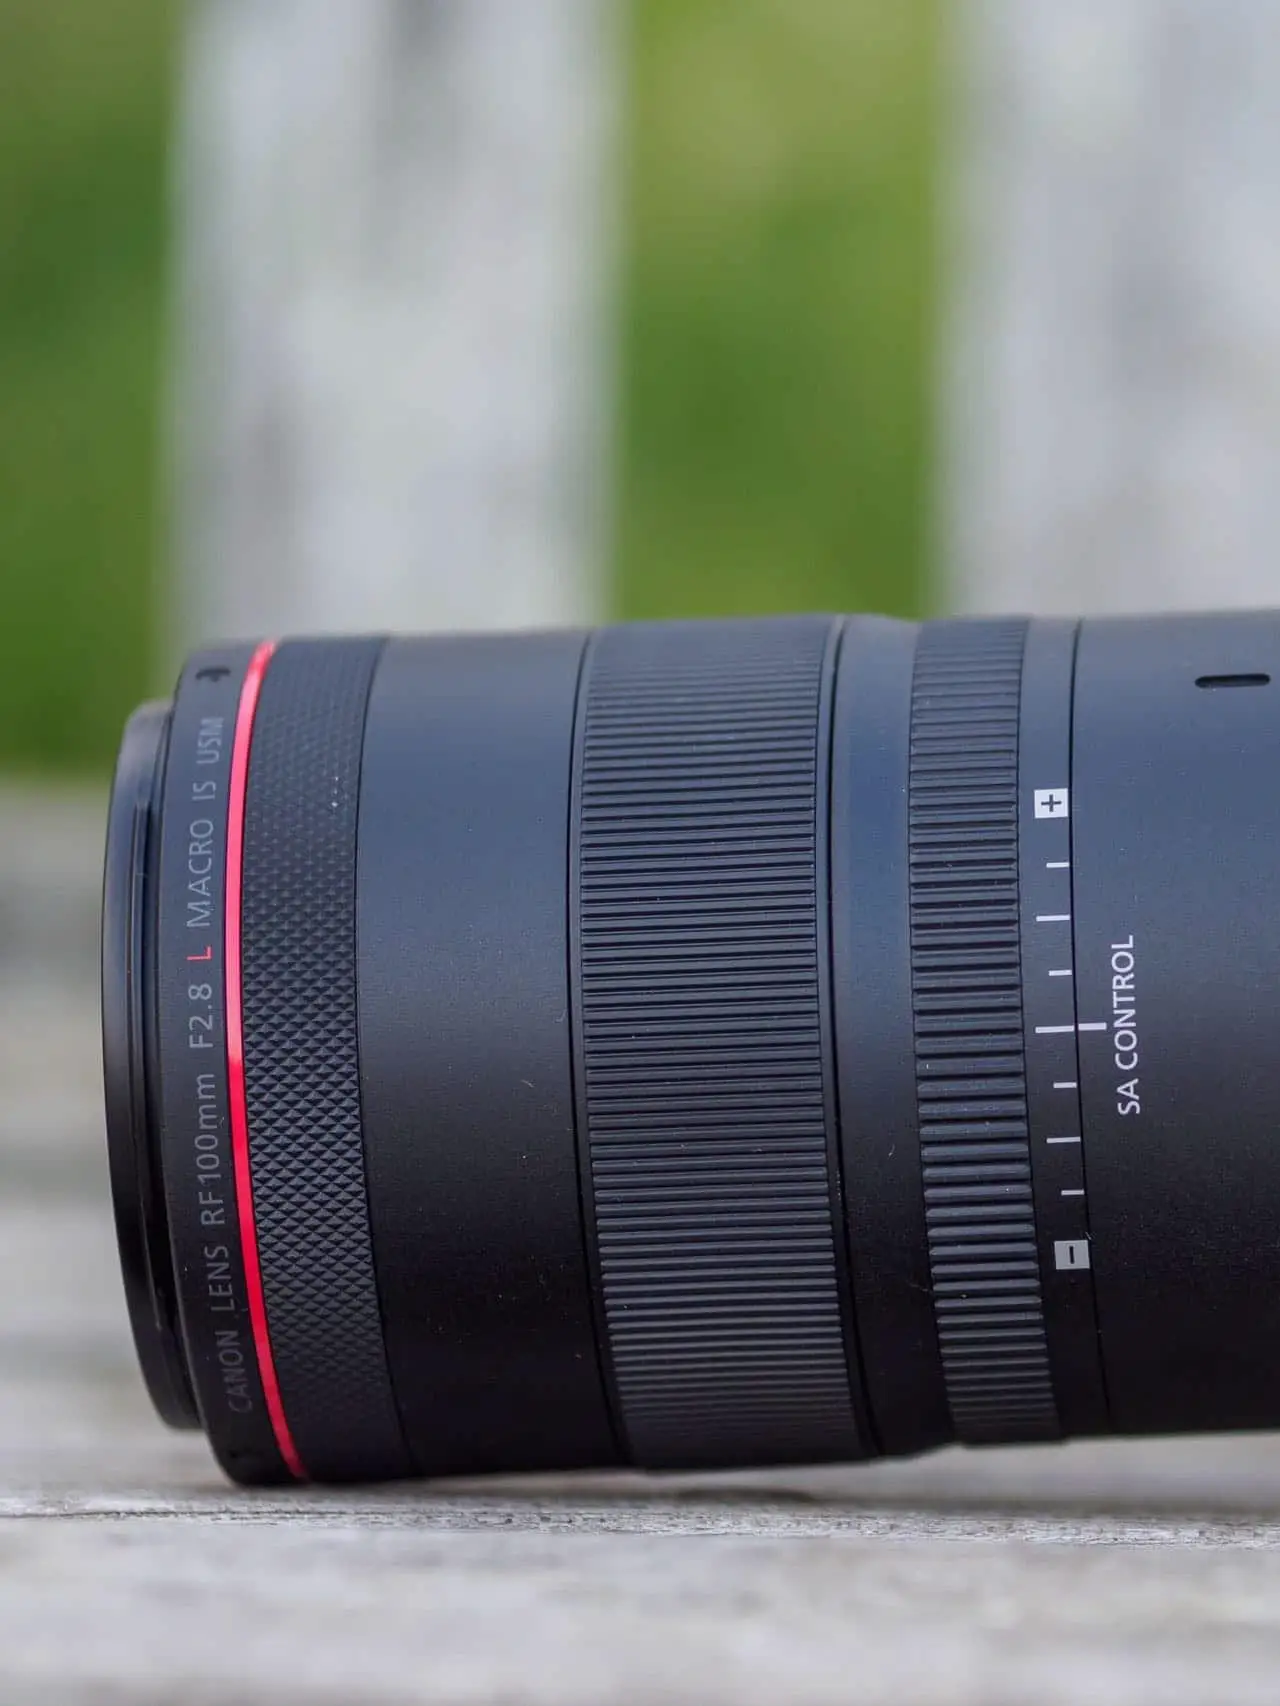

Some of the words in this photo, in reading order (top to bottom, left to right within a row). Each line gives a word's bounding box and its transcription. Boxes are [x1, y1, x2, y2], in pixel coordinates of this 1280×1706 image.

[196, 716, 224, 765] USM
[192, 780, 217, 801] IS
[186, 818, 214, 928] MACRO
[186, 945, 212, 961] L
[188, 982, 213, 1049] F2.8
[1111, 935, 1138, 1070] CONTROL
[1117, 1078, 1140, 1115] SA
[206, 1244, 233, 1312] LENS
[215, 1329, 252, 1413] CANON
